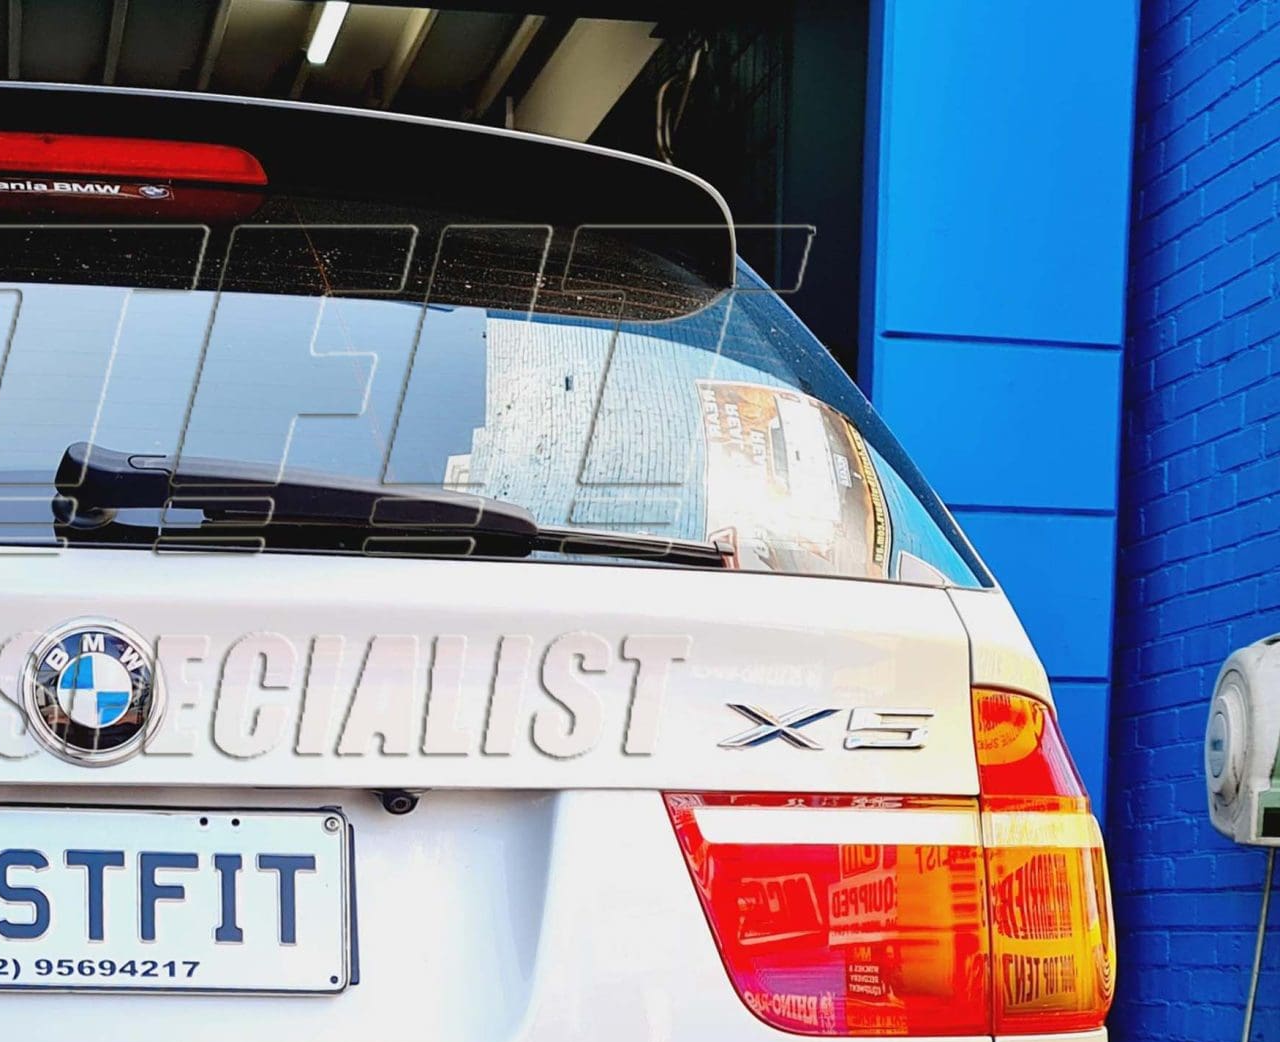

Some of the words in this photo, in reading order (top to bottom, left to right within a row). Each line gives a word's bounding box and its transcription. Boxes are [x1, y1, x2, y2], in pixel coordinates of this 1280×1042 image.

[53, 182, 121, 196] BMW
[45, 633, 144, 672] BMW
[717, 703, 936, 751] X5
[34, 958, 201, 978] 95694217
